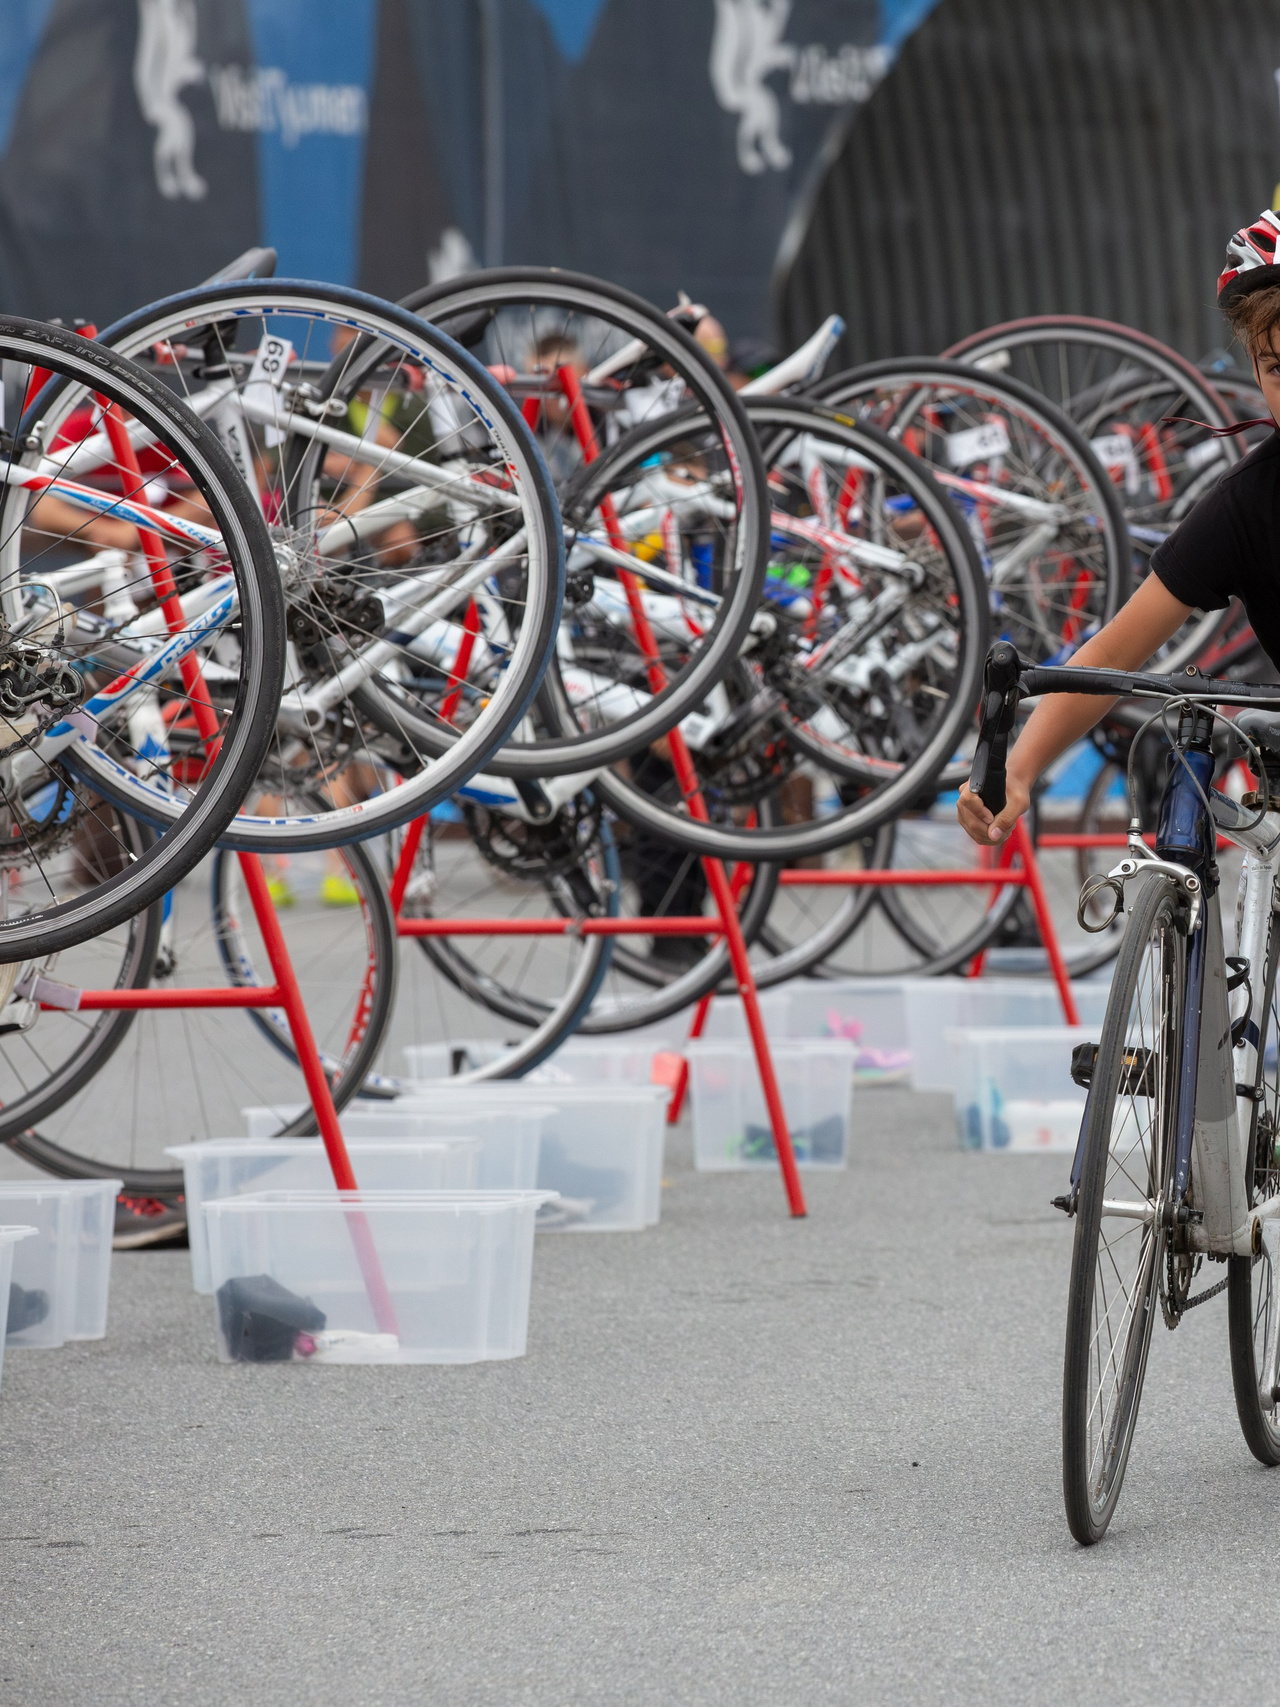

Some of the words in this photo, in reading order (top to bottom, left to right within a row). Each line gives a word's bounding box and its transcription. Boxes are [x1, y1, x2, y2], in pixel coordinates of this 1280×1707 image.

[22, 328, 111, 367] ZAFFIRO
[112, 363, 152, 393] PRO
[262, 340, 284, 373] 69
